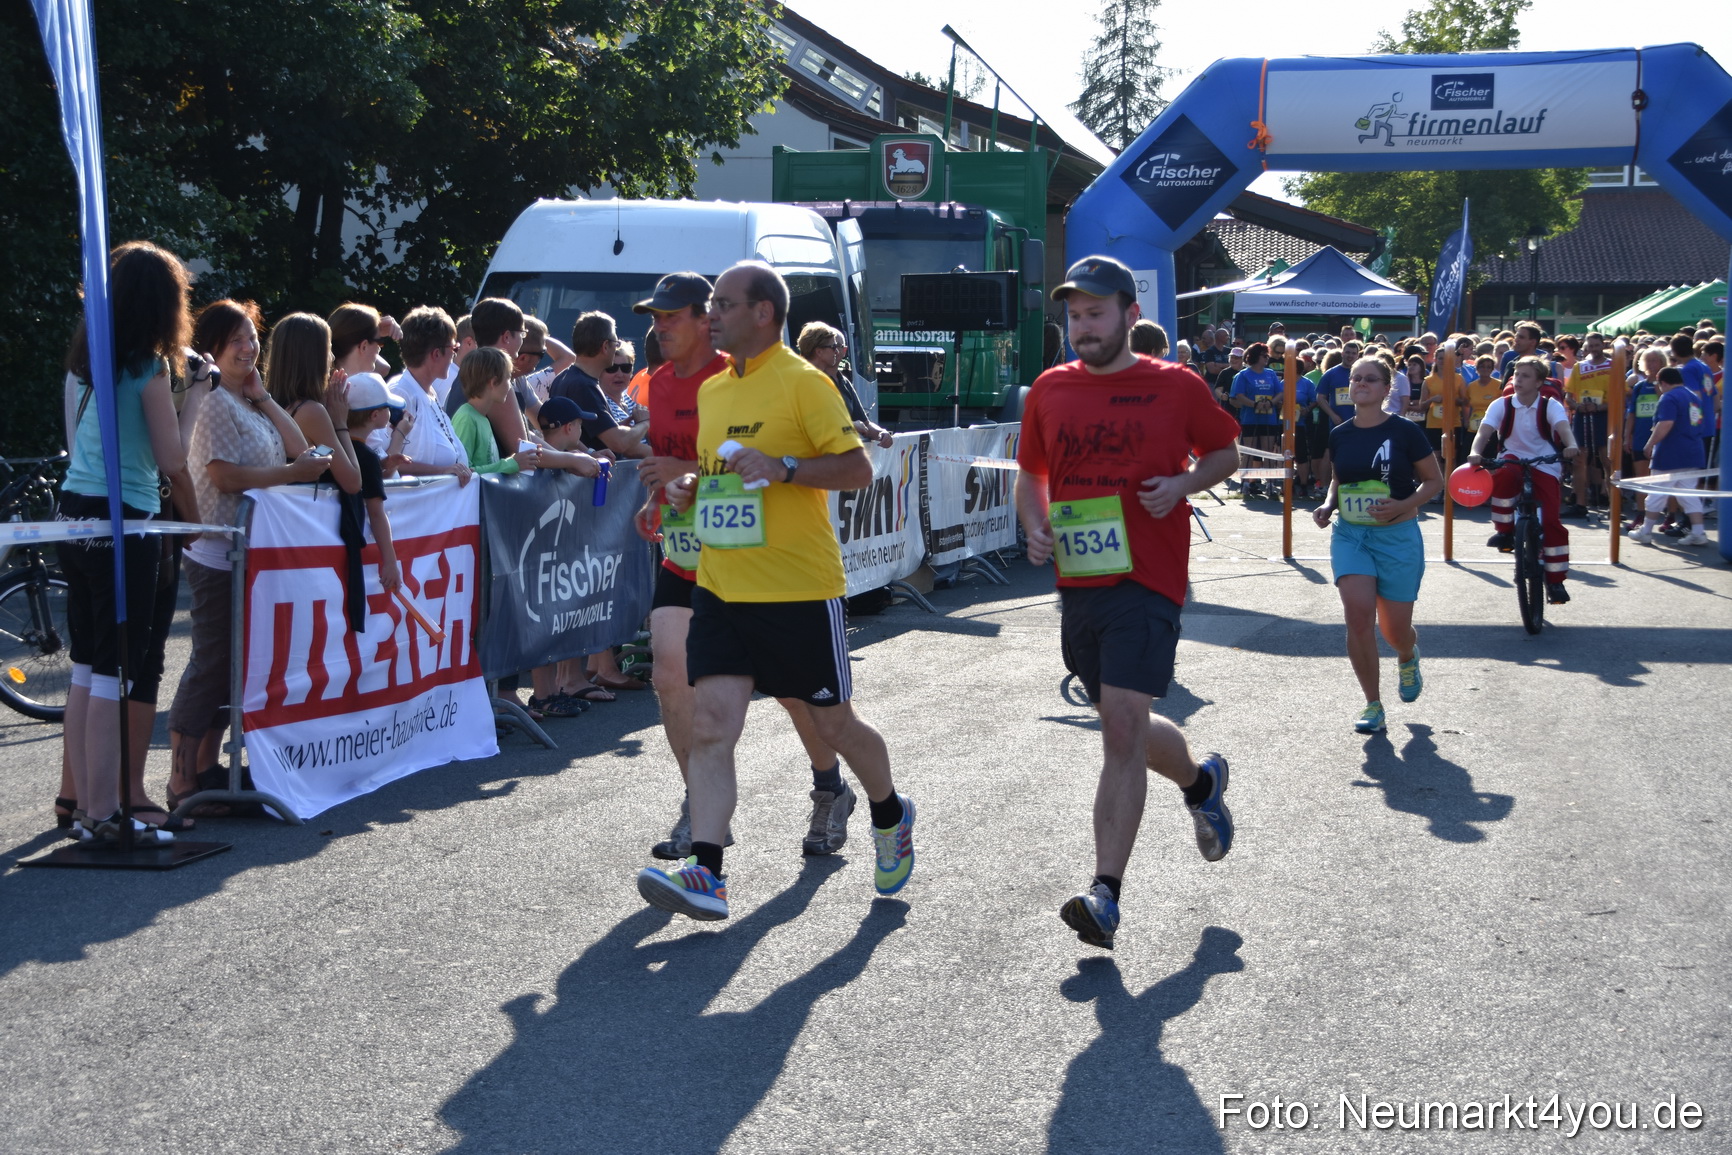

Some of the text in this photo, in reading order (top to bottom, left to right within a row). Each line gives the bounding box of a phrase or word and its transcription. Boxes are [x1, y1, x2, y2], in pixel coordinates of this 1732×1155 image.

[1444, 88, 1491, 97] Fischer
[1408, 109, 1548, 136] firmenlauf
[1406, 136, 1463, 146] neumarkt
[1695, 152, 1717, 164] und
[1150, 165, 1221, 179] Fischer
[896, 185, 918, 194] 1628
[1269, 300, 1381, 309] www.fischer-automobile.de
[727, 425, 749, 435] swn
[1063, 475, 1129, 488] Alles läuft
[700, 504, 756, 528] 1525
[669, 531, 702, 553] 153
[1058, 528, 1120, 556] 1534
[538, 545, 622, 604] Fischer
[551, 601, 614, 635] AUTOMOBILE
[273, 691, 458, 773] www.meier-baustoffe.de
